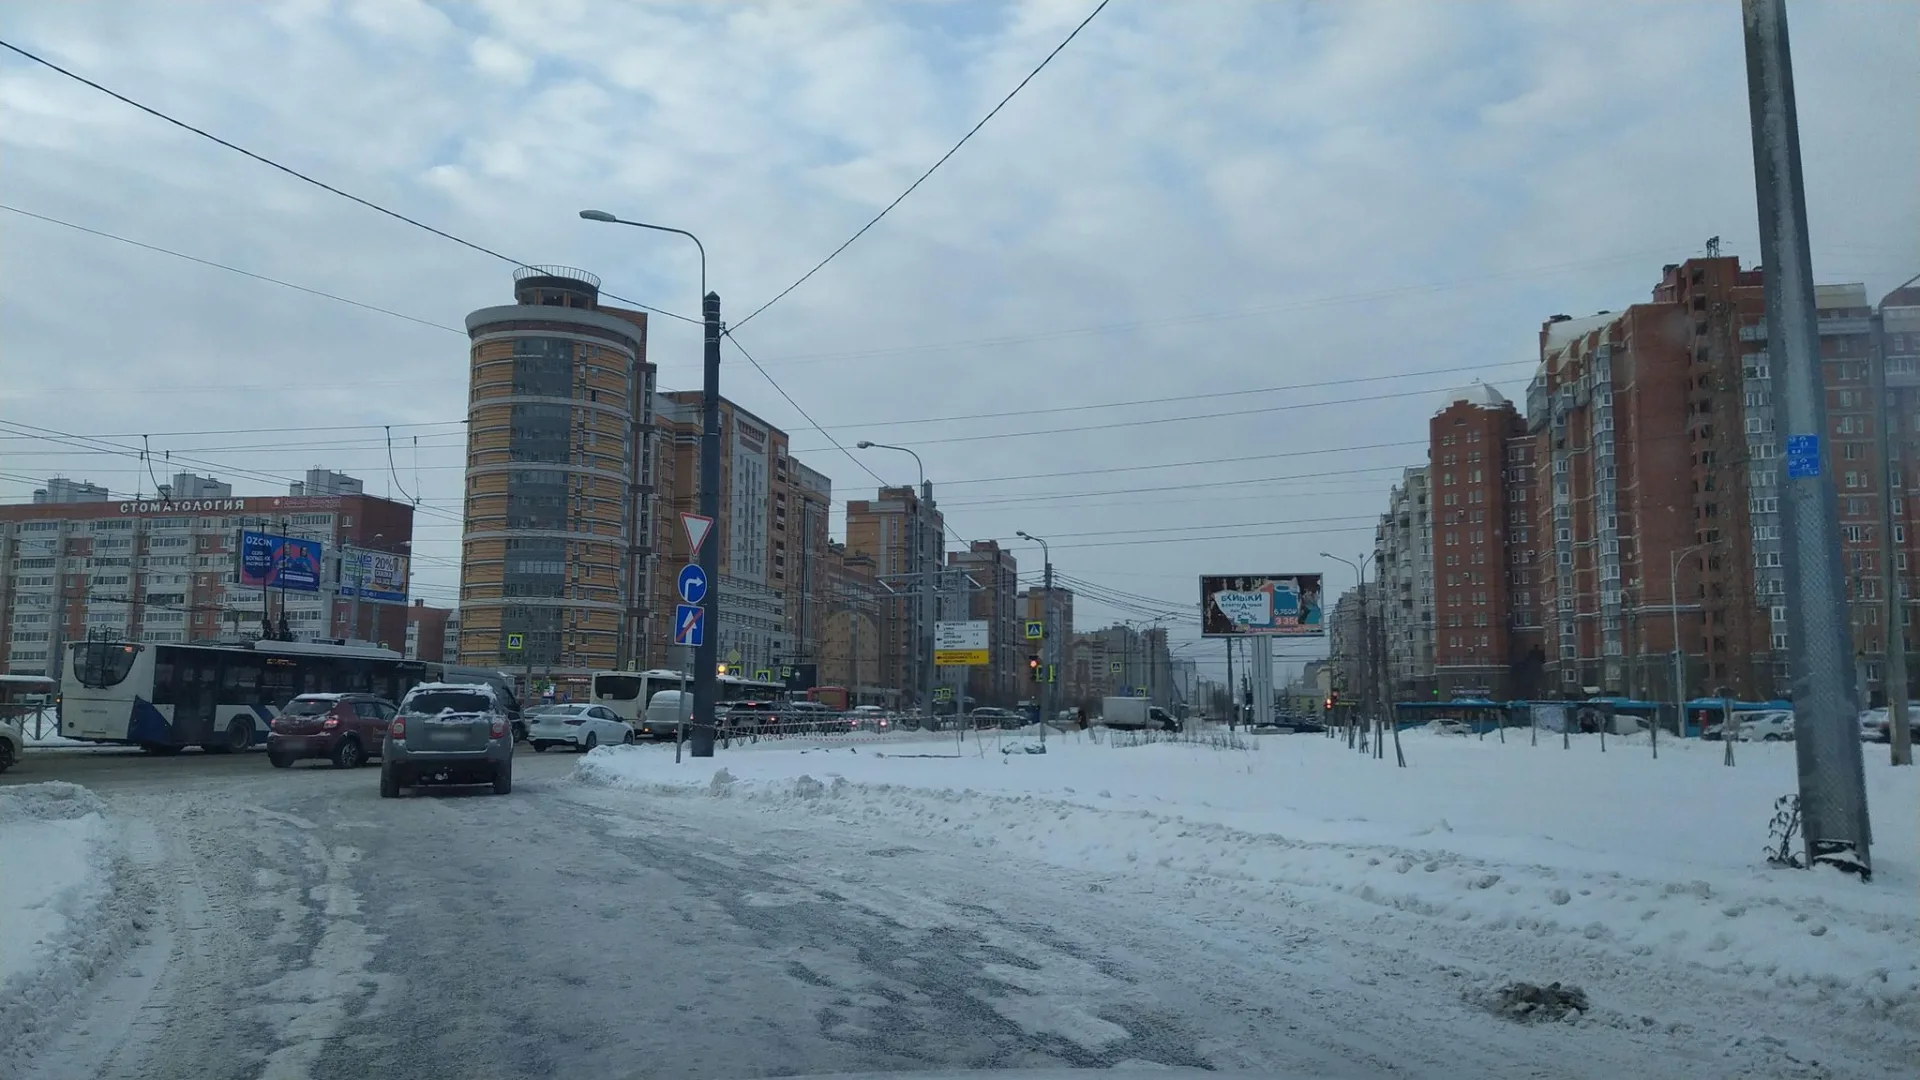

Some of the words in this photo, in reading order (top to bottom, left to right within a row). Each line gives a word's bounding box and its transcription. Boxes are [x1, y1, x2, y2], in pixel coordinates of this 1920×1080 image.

[120, 499, 245, 513] СТОМАТОЛОГИЯ
[246, 536, 272, 547] OZON
[375, 556, 393, 571] 20%
